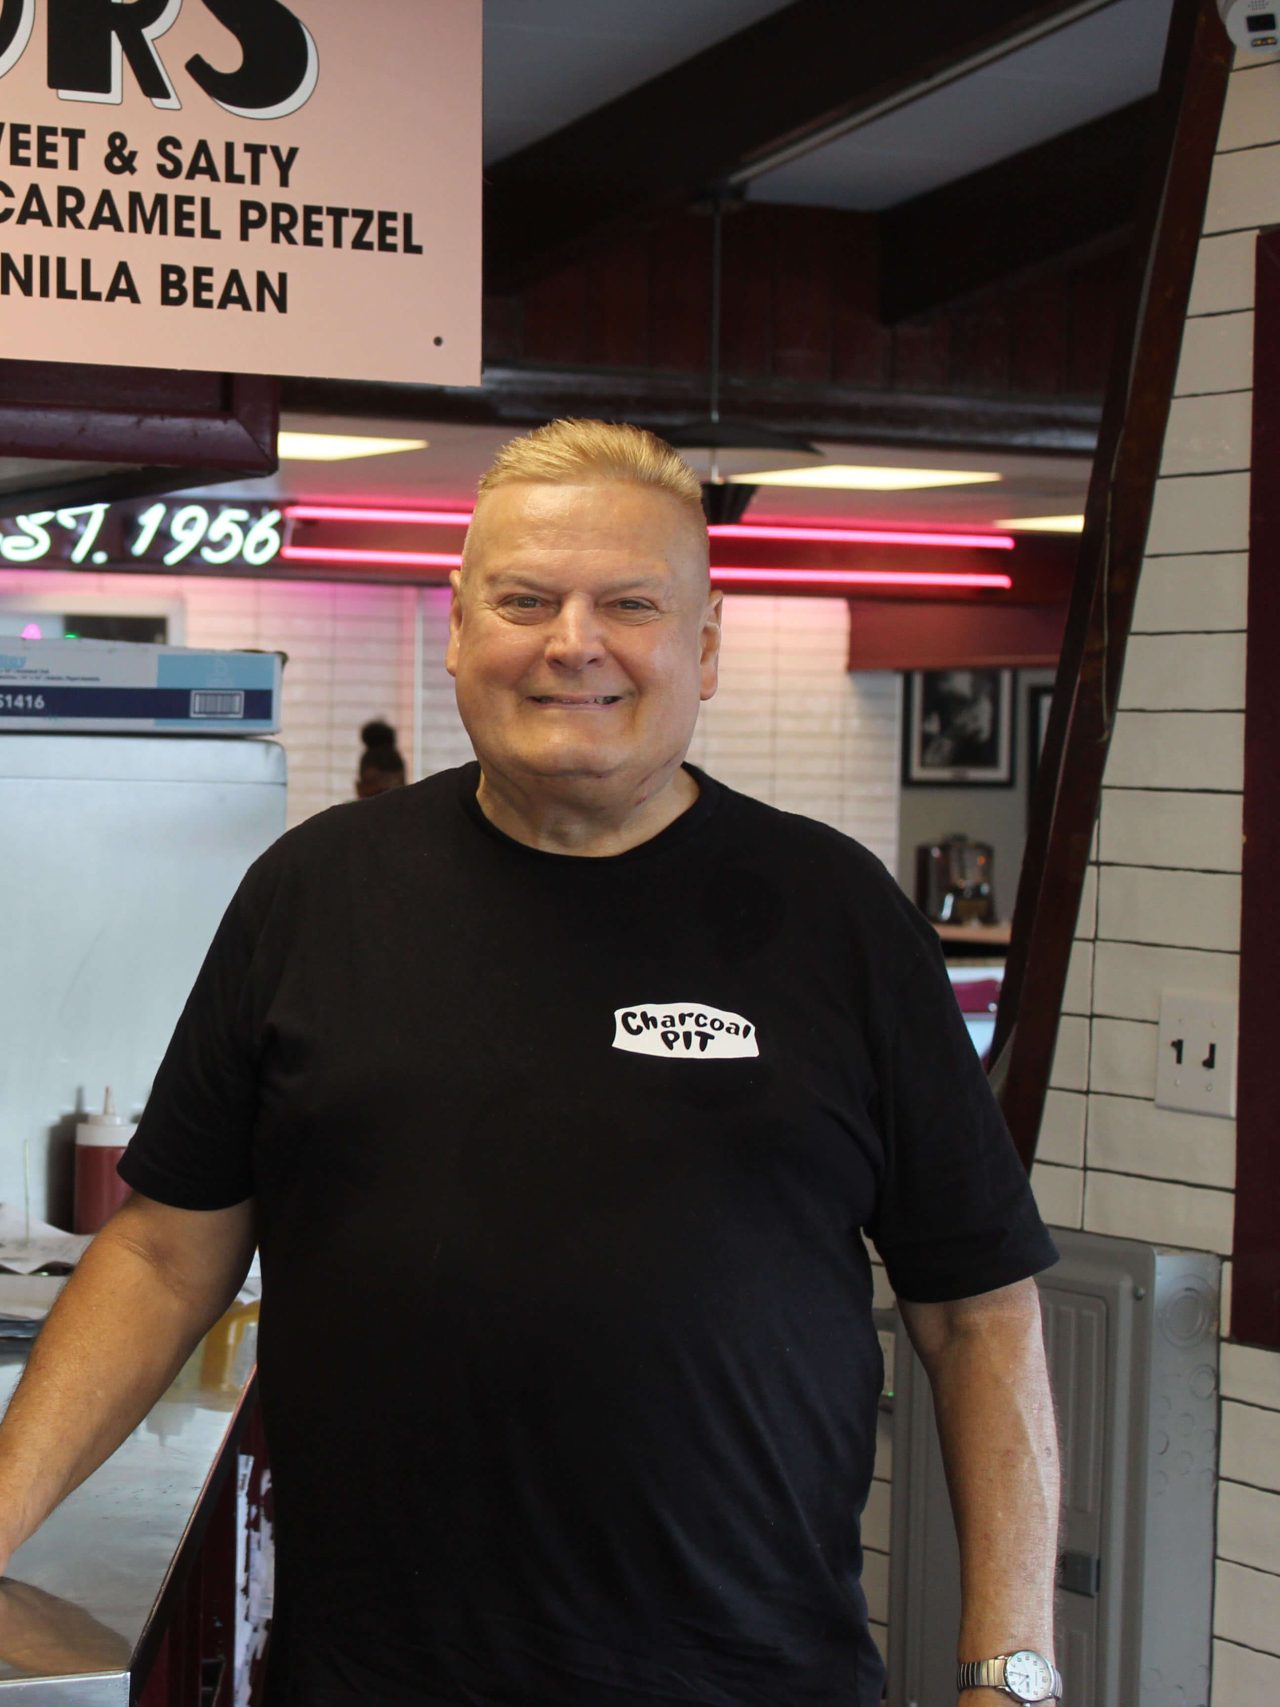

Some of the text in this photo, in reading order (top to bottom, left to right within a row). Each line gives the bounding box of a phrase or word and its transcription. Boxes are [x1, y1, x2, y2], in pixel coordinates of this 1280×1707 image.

[104, 131, 138, 176] &
[156, 133, 299, 188] SALTY
[240, 200, 423, 255] PRETZEL
[161, 264, 287, 314] BEAN
[131, 502, 282, 566] 1956
[621, 1010, 752, 1040] Charcoal
[660, 1030, 715, 1052] PIT
